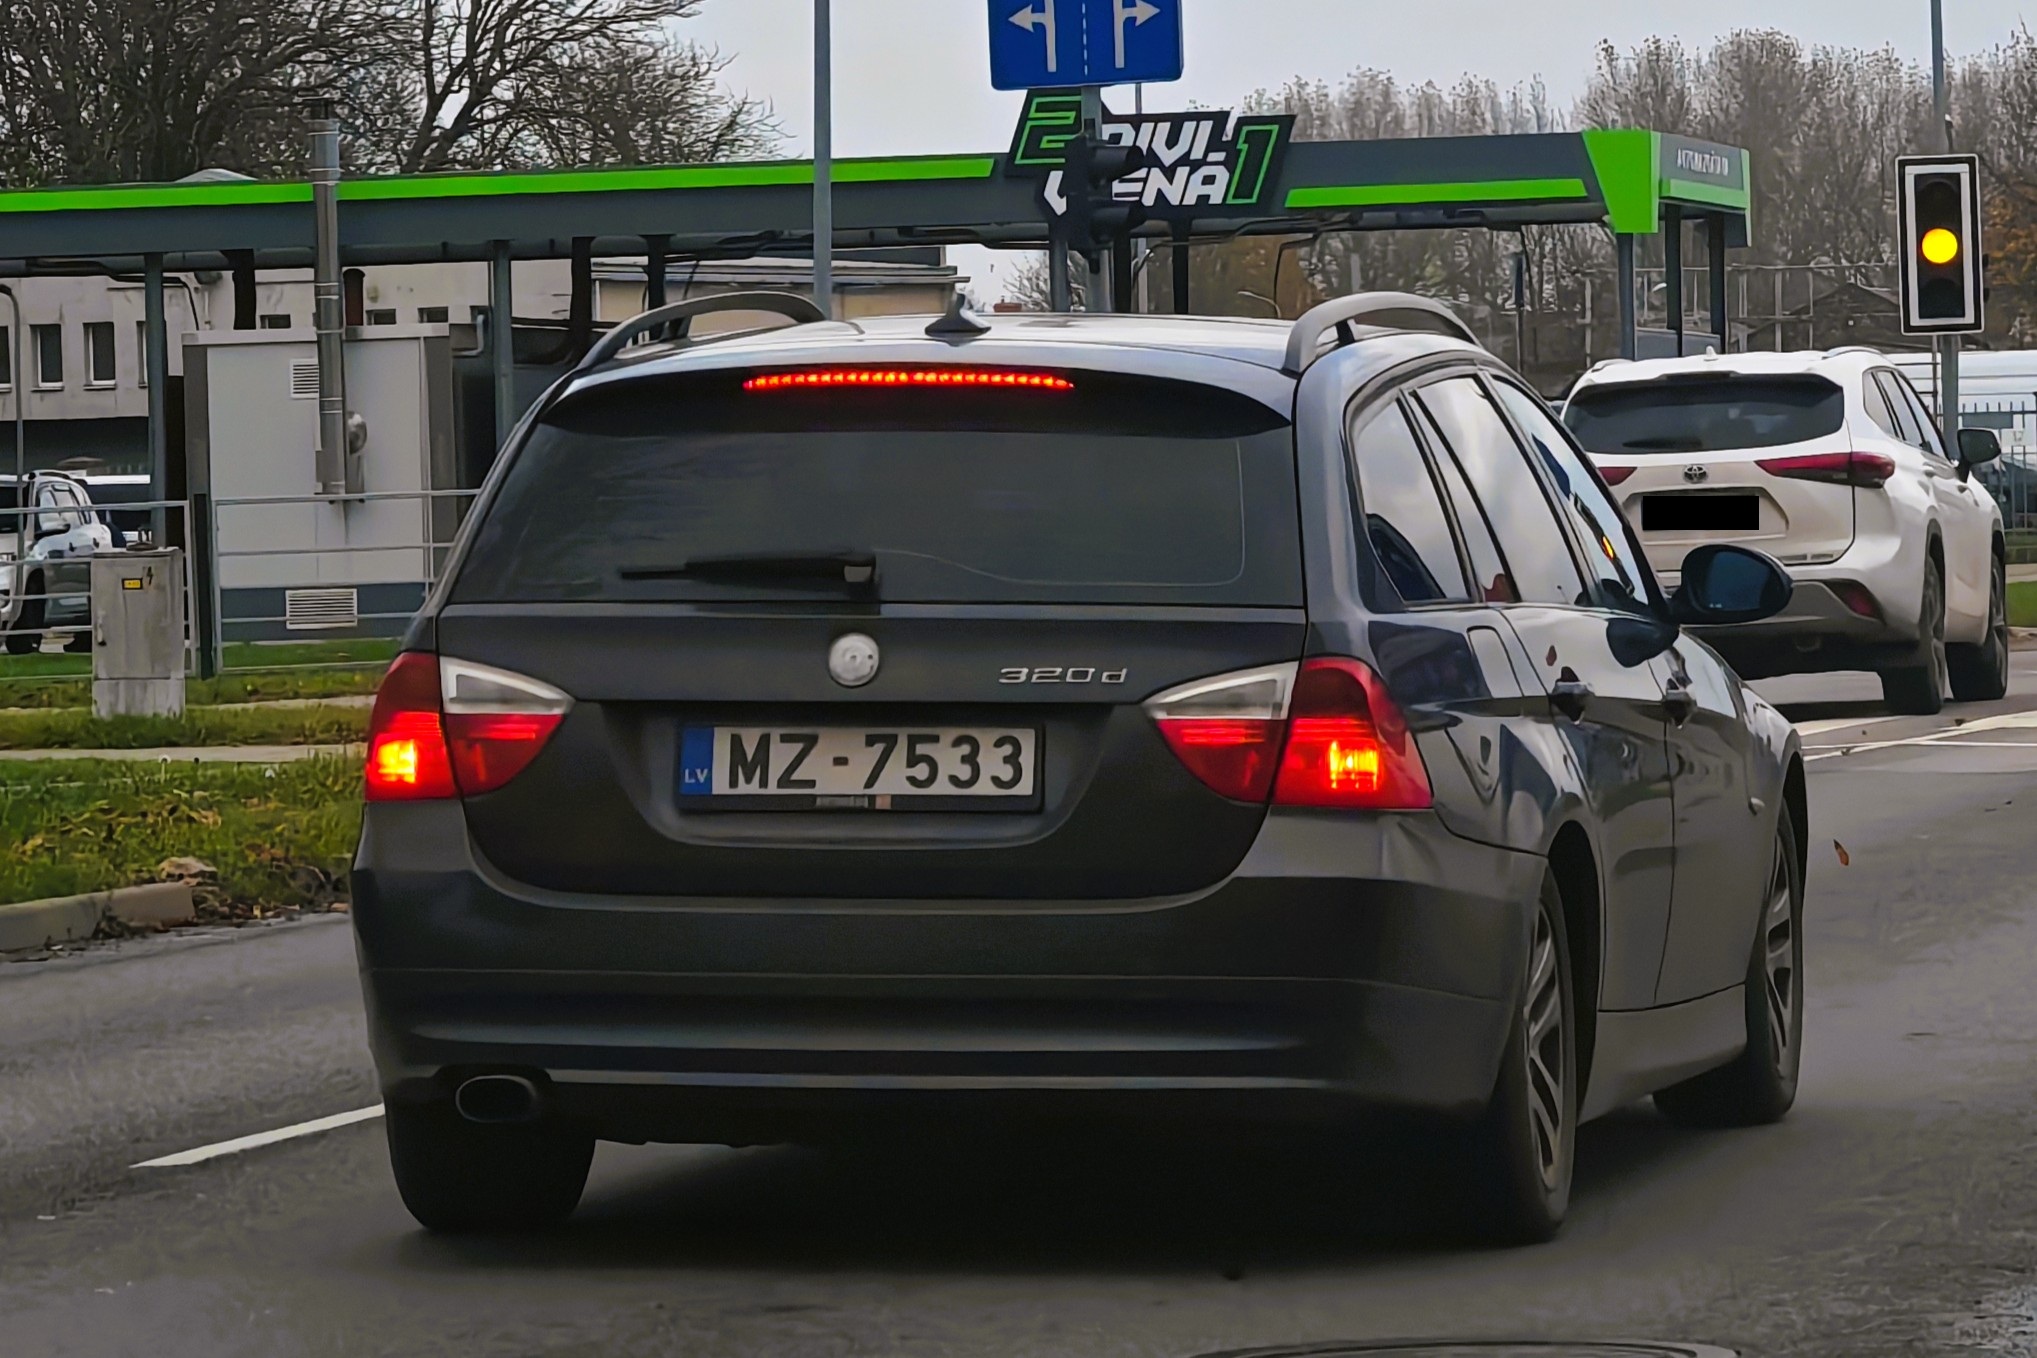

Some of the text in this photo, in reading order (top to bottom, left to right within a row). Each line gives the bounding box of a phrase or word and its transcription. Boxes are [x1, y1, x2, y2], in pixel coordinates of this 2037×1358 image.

[1044, 153, 1229, 216] VENĀ
[1226, 125, 1279, 204] 1
[684, 769, 708, 783] LV
[728, 733, 1023, 789] MZ-7533
